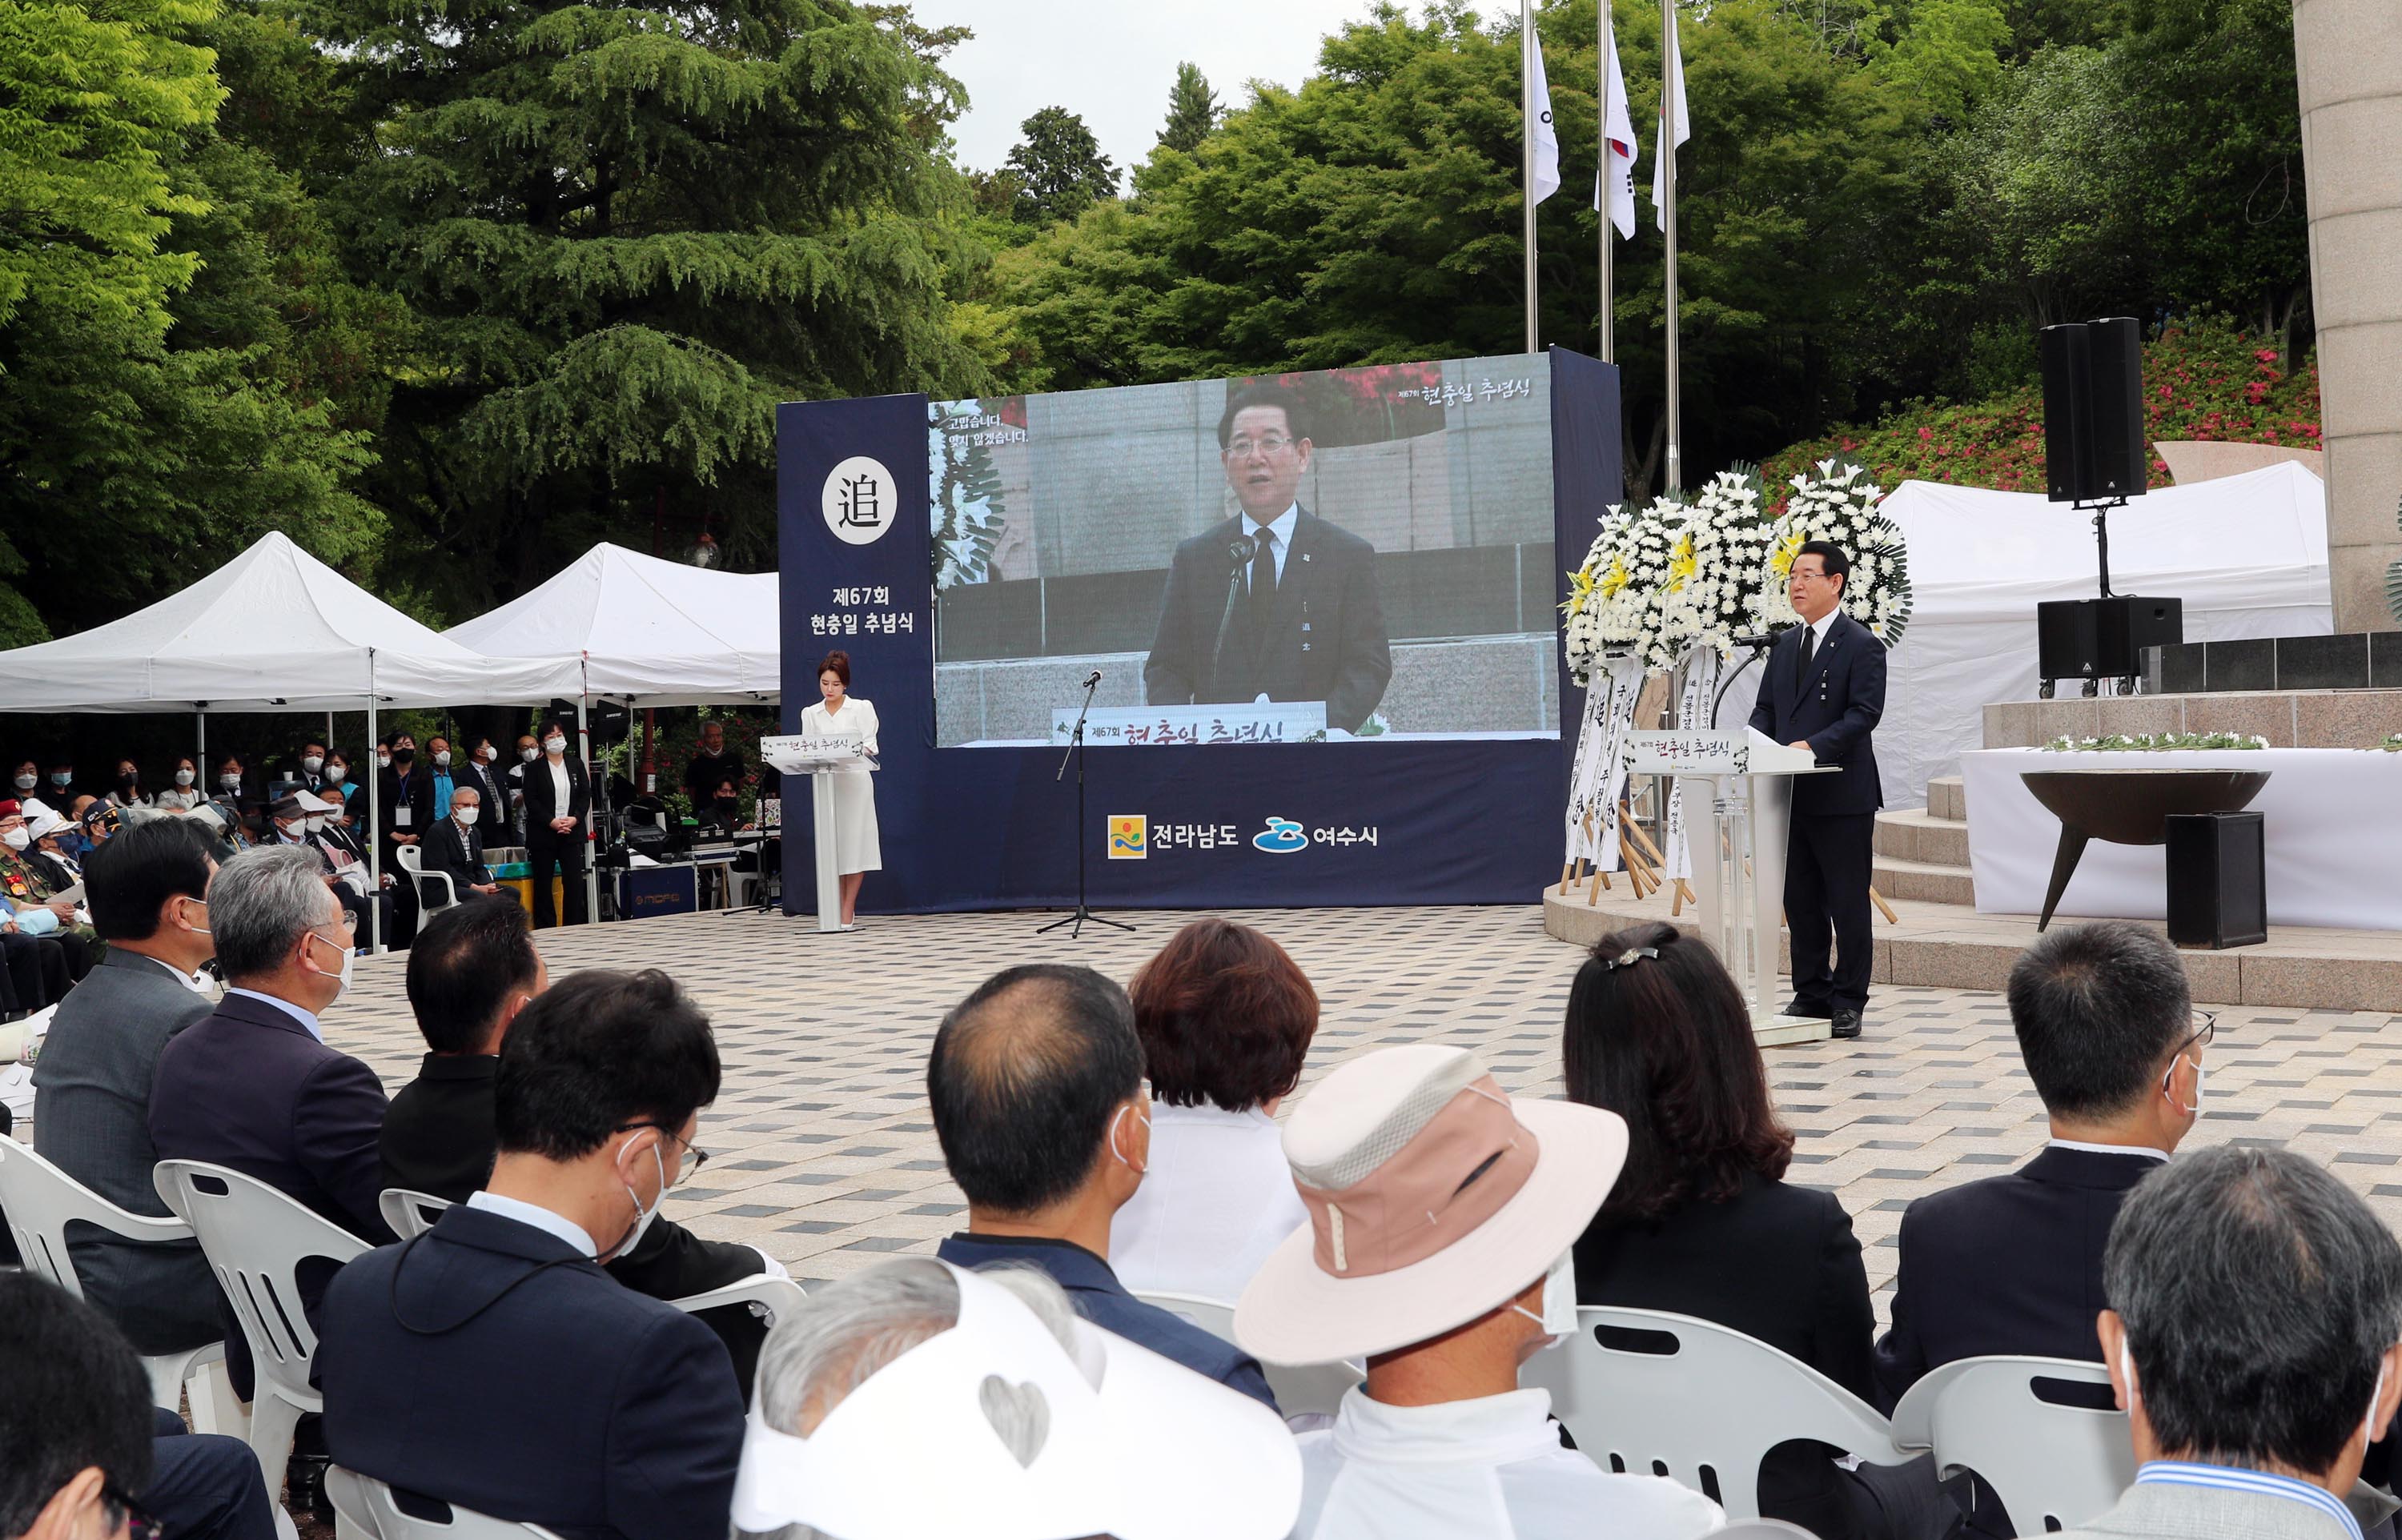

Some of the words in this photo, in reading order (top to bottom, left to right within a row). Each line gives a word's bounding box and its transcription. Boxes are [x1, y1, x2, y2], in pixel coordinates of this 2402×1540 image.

[1421, 382, 1473, 407] 현충일
[1480, 378, 1529, 402] 추념식
[948, 414, 1003, 430] 고맙습니다.
[948, 433, 969, 448] 잊지
[973, 429, 1029, 447] 않겠습니다.
[837, 474, 882, 528] 追
[832, 585, 890, 607] 제67회
[810, 613, 858, 636] 현충일
[865, 612, 914, 634] 추념식
[1091, 726, 1120, 738] 제67회
[1655, 737, 1691, 760] 현충일
[1693, 738, 1729, 760] 추념식
[1153, 824, 1239, 848] 전라남도
[1313, 826, 1378, 847] 여수시
